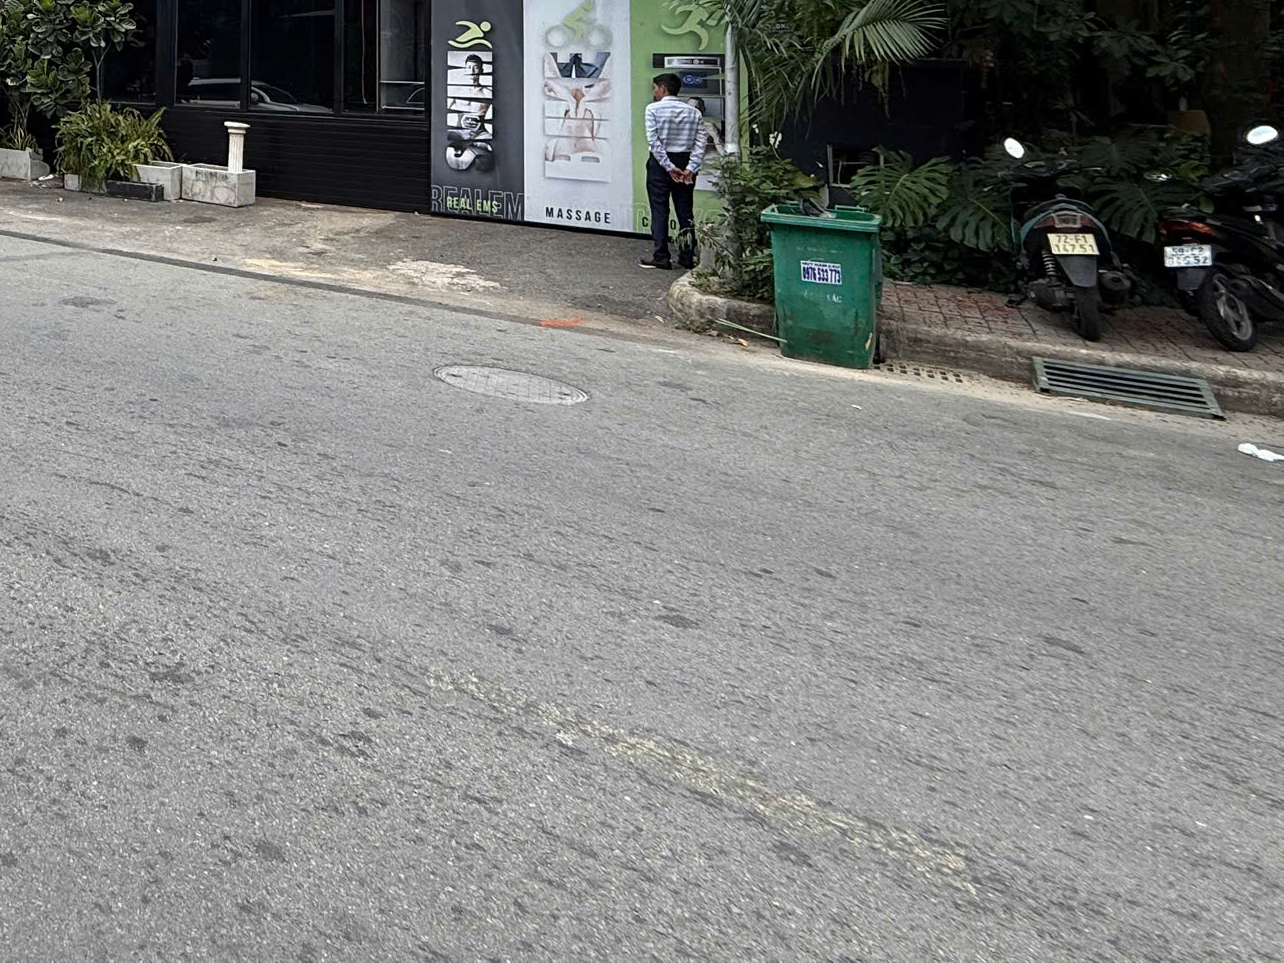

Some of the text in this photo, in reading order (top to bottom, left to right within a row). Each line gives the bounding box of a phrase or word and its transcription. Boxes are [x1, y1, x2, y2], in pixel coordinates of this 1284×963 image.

[447, 196, 498, 213] REAL EMS
[545, 206, 611, 224] MASSAGE
